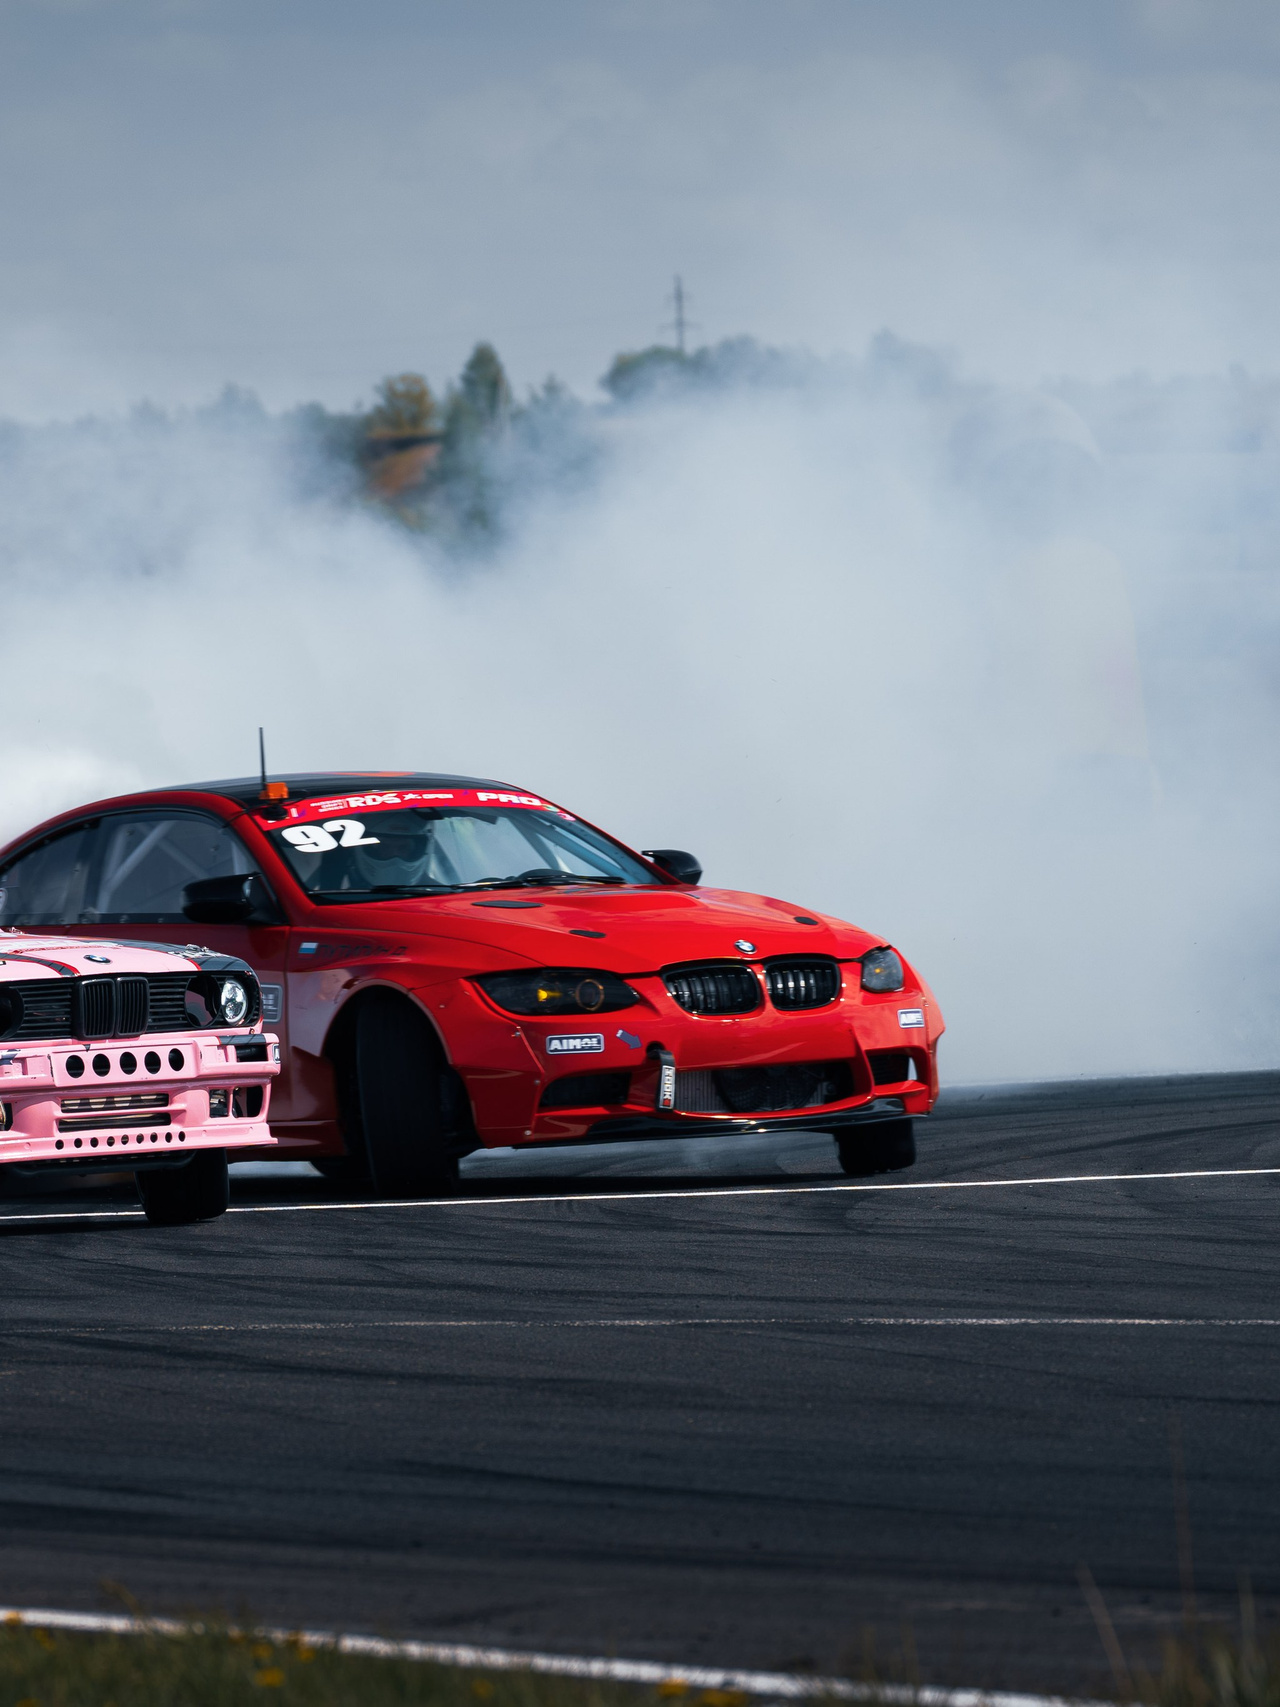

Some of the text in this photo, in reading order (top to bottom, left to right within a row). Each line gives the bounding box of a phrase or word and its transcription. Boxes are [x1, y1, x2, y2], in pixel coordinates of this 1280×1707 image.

[345, 793, 401, 808] RDS
[476, 792, 543, 806] PRO
[281, 819, 381, 853] 92
[549, 1038, 601, 1050] AIMOL
